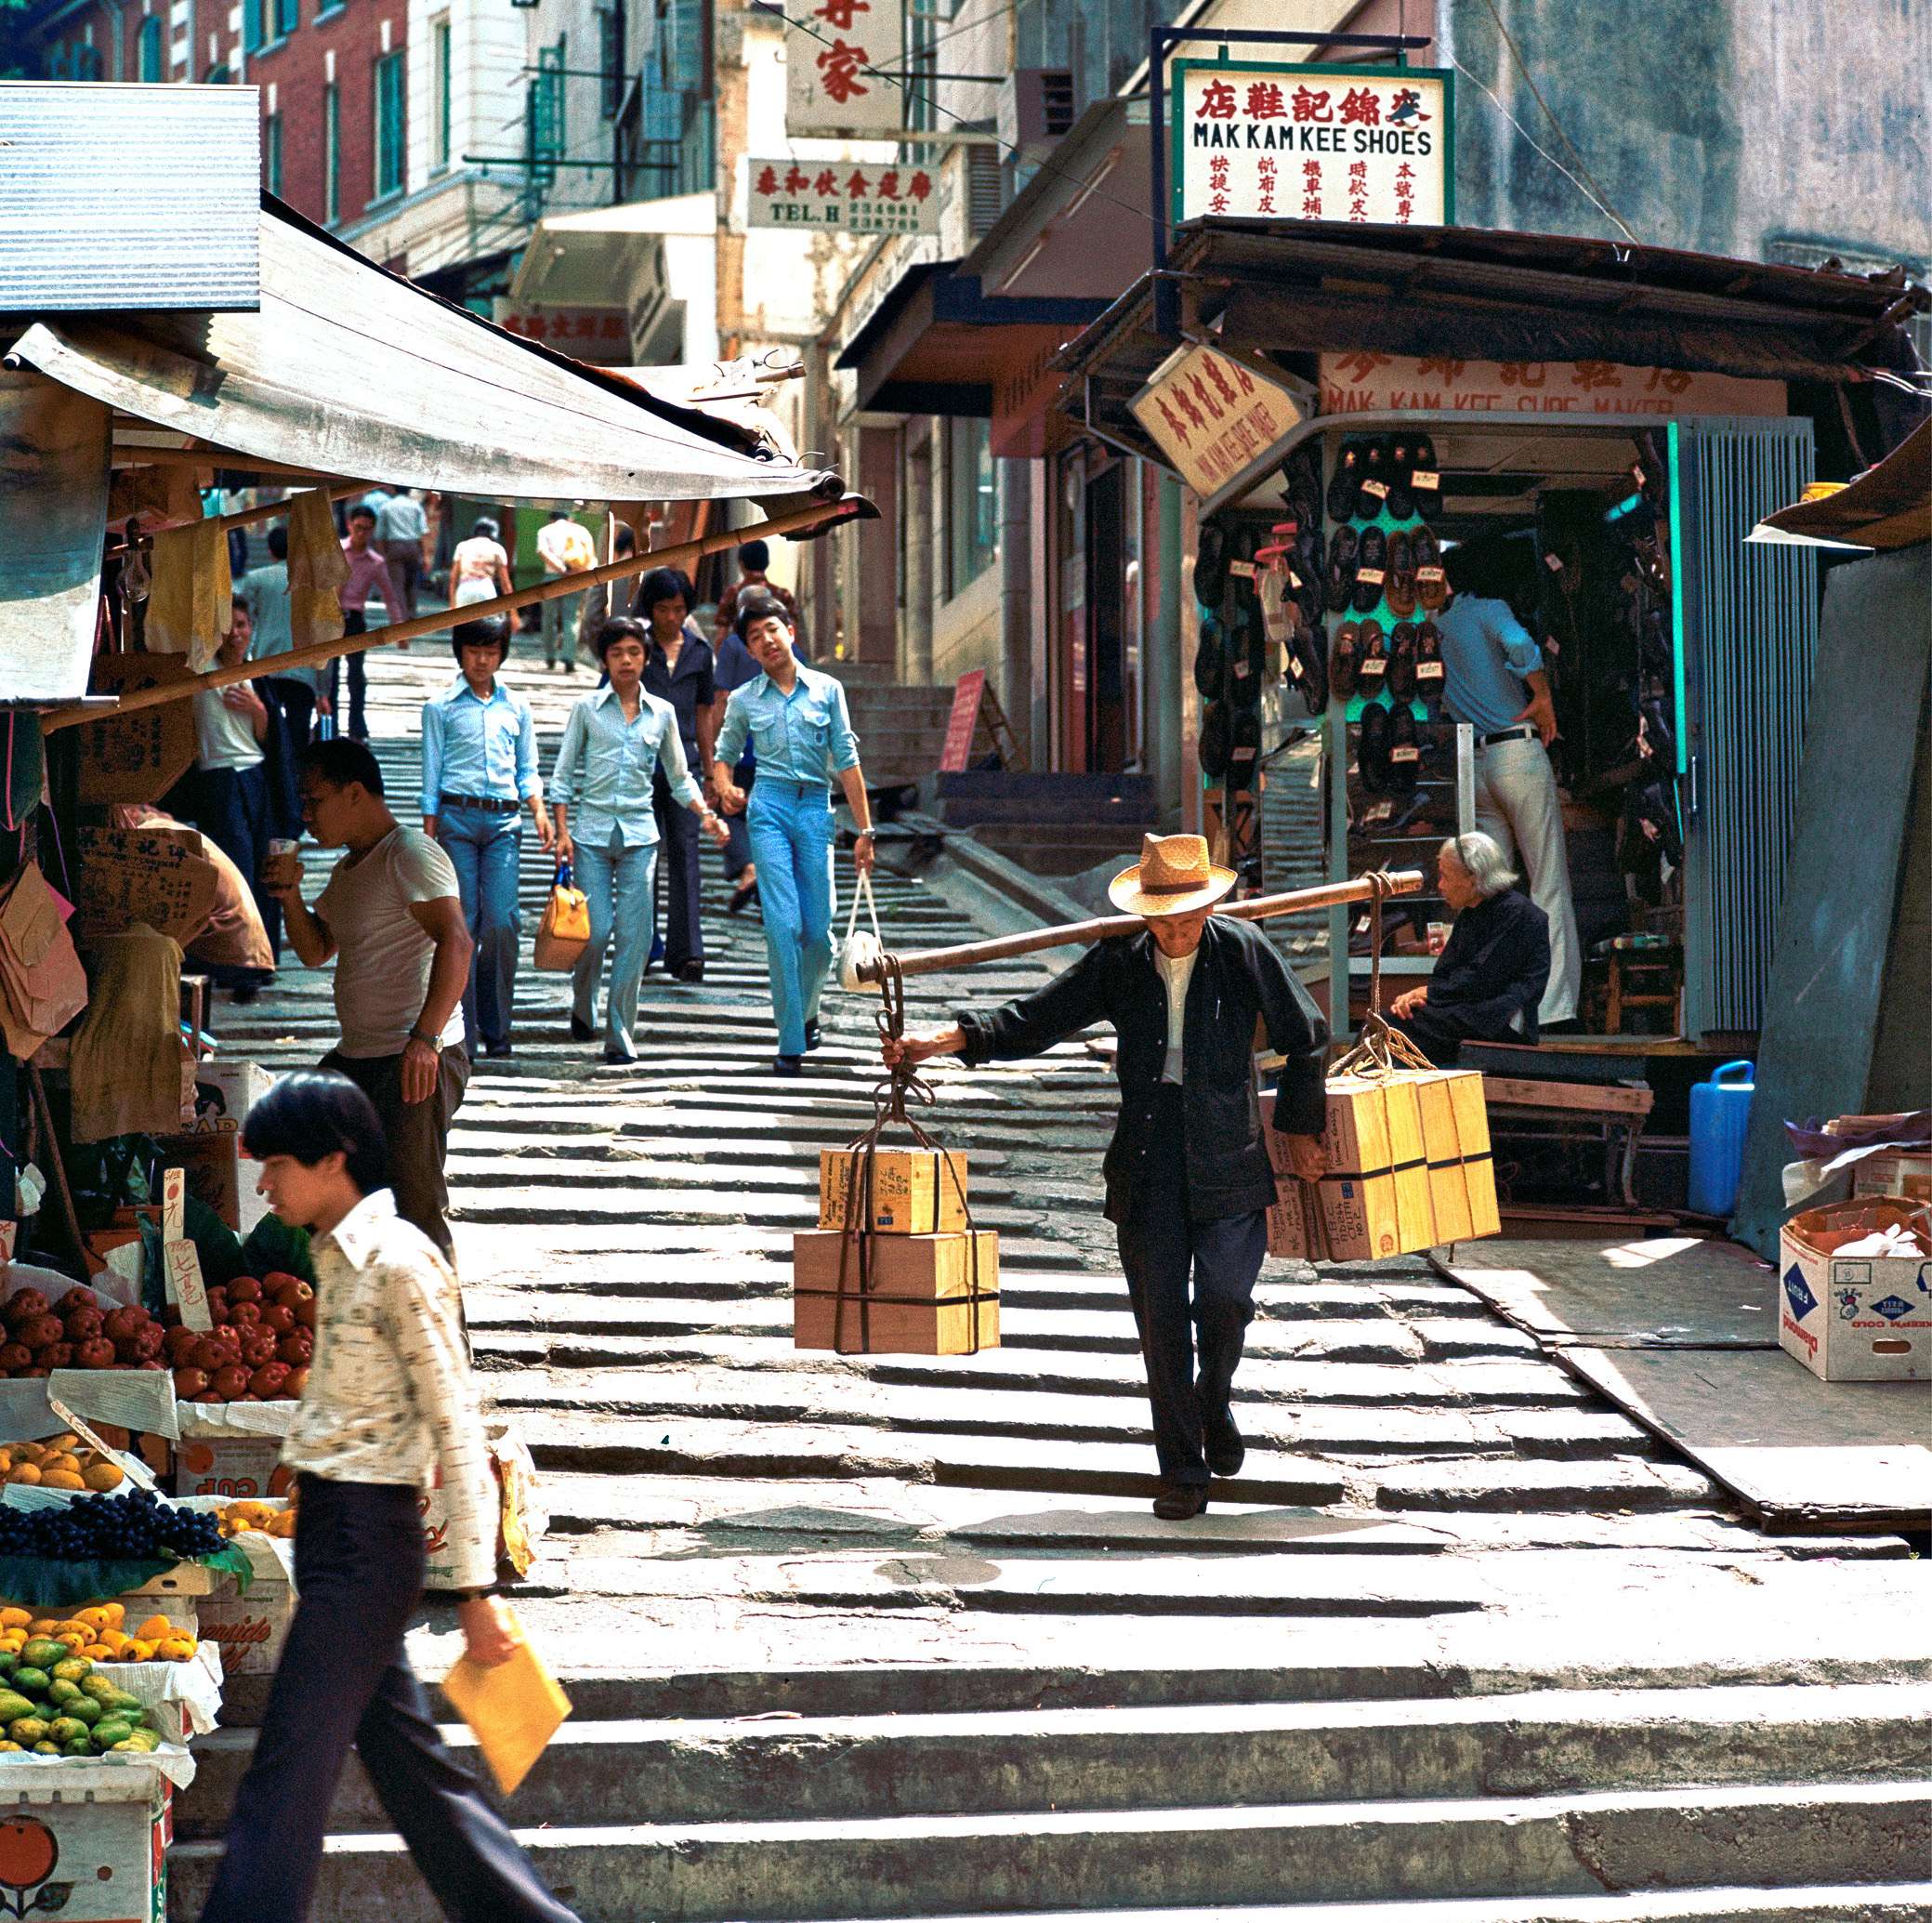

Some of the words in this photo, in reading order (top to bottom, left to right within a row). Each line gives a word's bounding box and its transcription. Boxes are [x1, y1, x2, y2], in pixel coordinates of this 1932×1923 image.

[1193, 123, 1241, 149] MAK
[1247, 125, 1294, 150] KAM
[1301, 126, 1347, 152] KEE
[1354, 128, 1432, 156] SHOES
[1257, 156, 1278, 217] 帆布皮
[1302, 159, 1322, 219] 機車補
[1394, 162, 1417, 224] 本號專
[1328, 390, 1373, 411] MAK
[1391, 391, 1440, 410] KAM
[1787, 1278, 1809, 1306] FRUIT
[1783, 1312, 1819, 1361] Diamond
[1851, 1320, 1886, 1329] COLD
